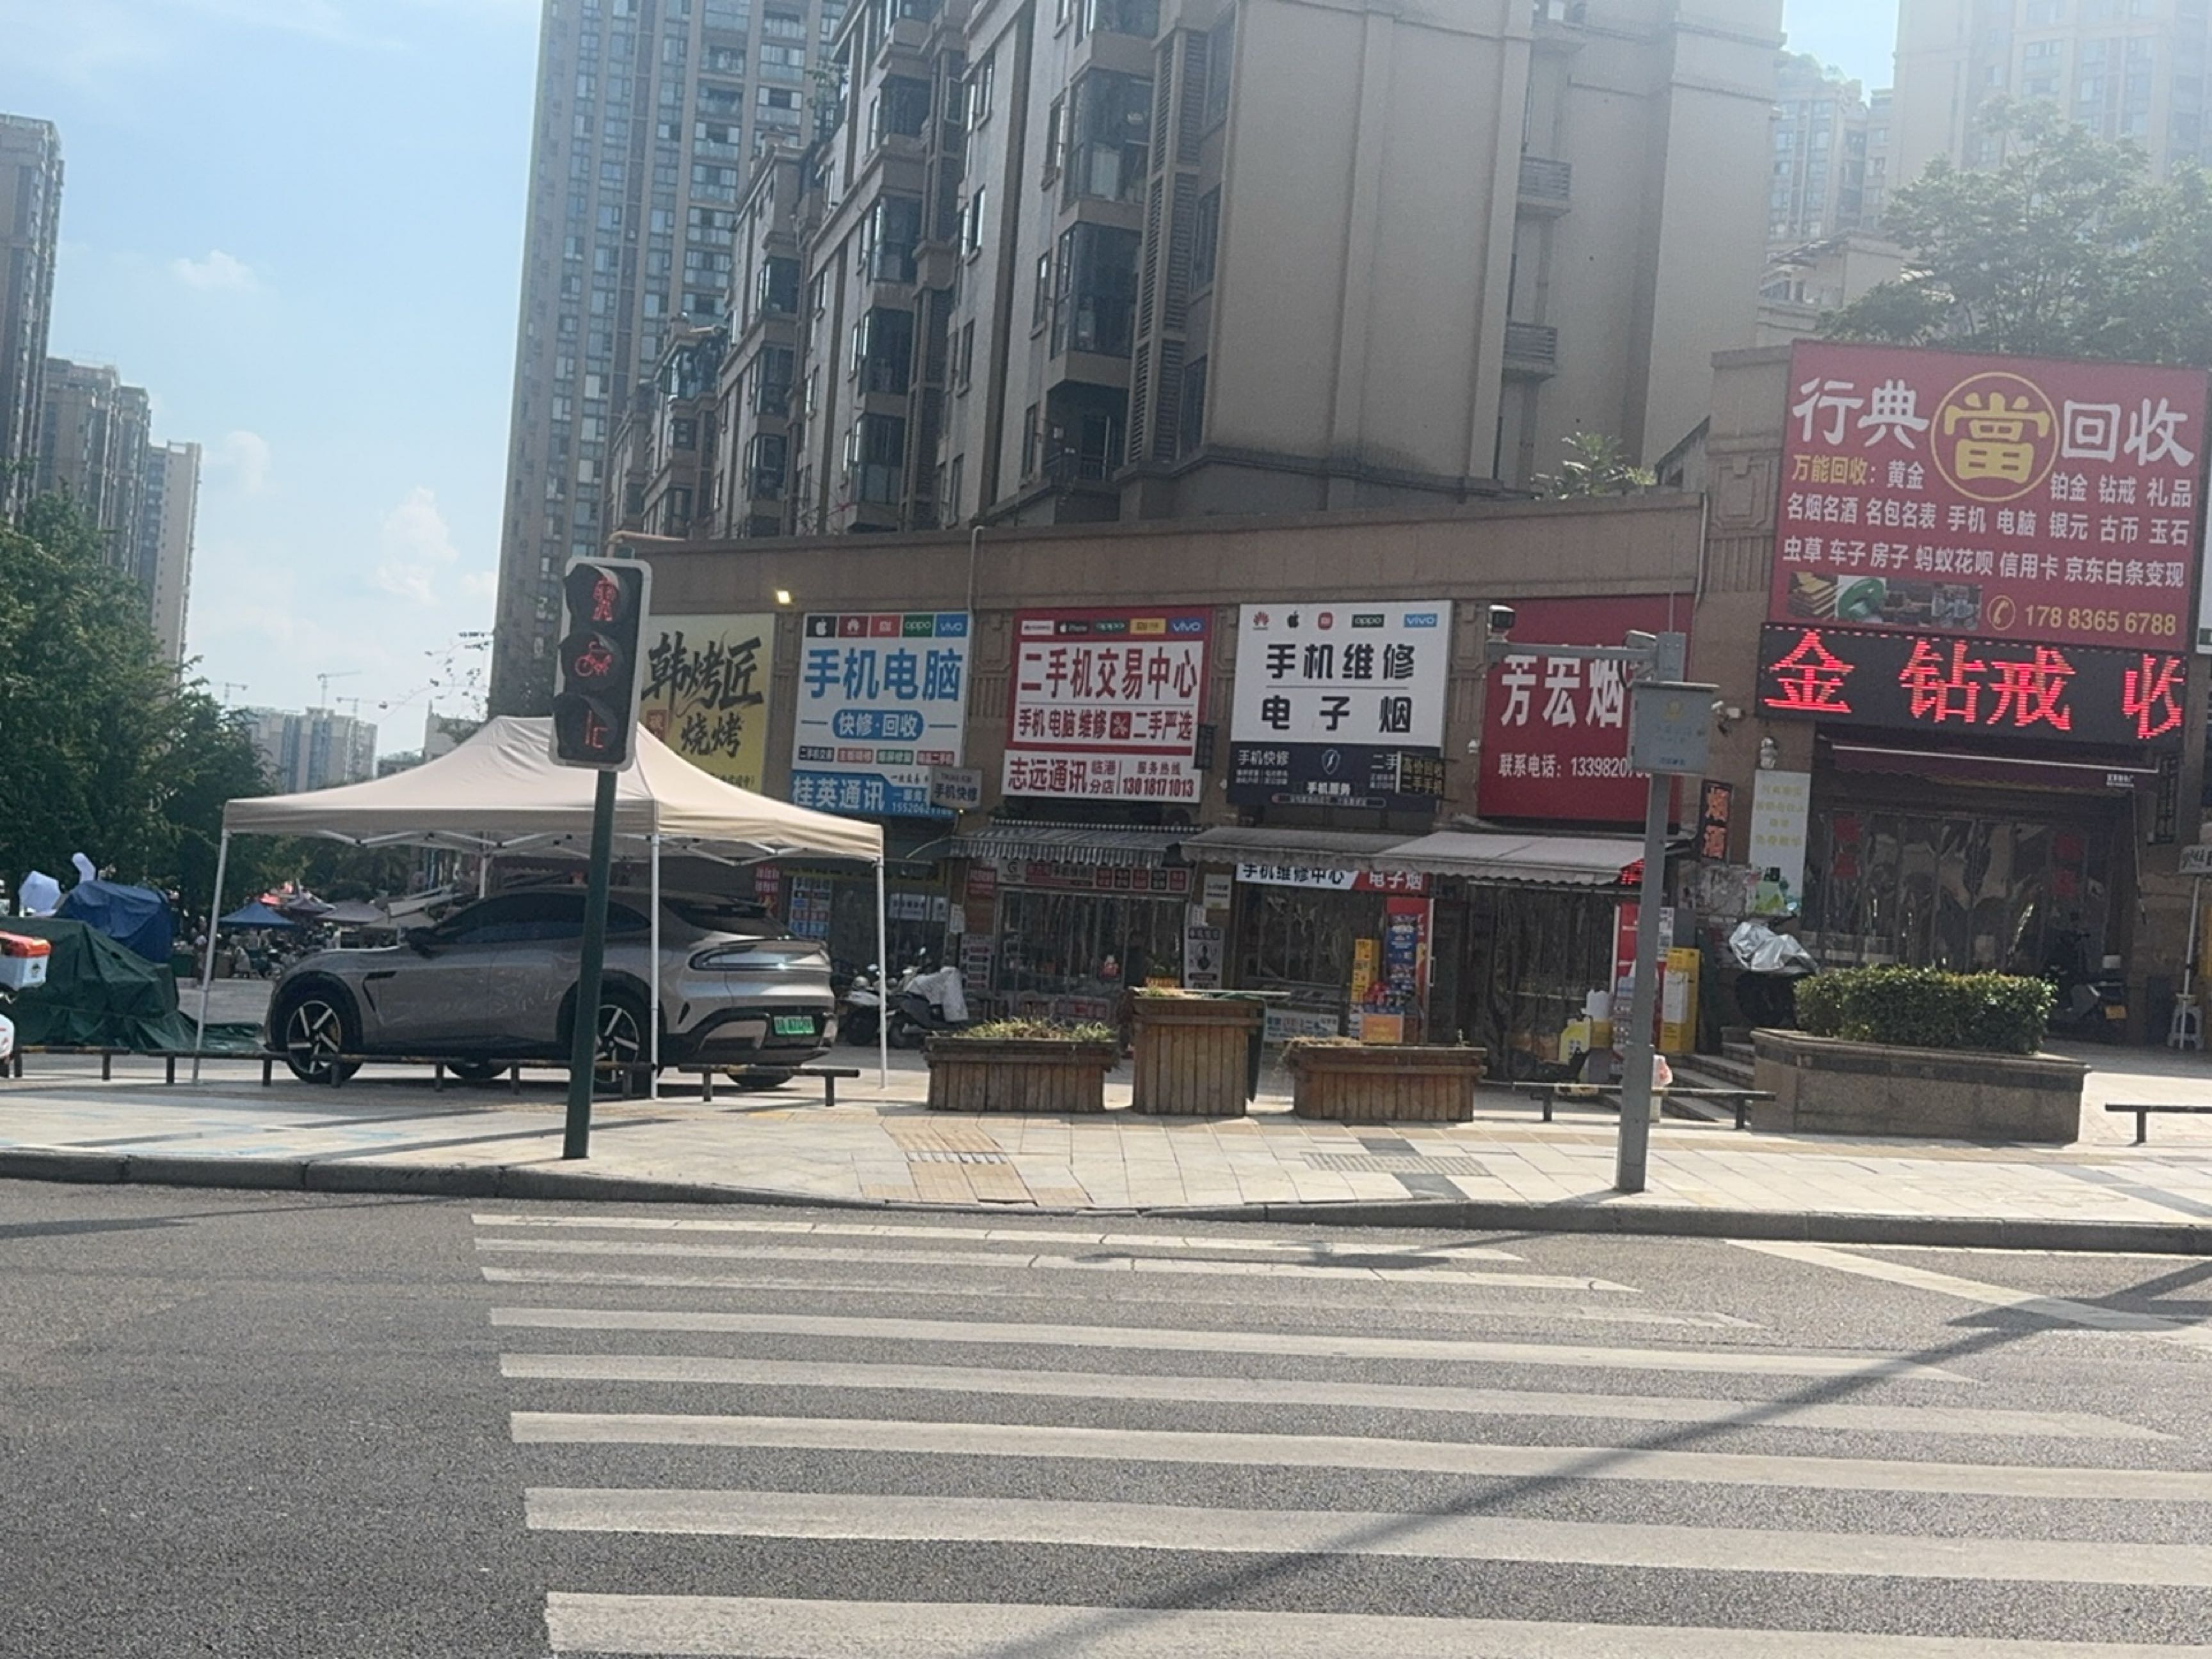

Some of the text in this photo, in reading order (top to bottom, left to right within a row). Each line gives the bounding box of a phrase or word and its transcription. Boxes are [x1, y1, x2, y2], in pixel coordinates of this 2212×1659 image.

[1793, 377, 1930, 449] 行典
[2062, 397, 2194, 467] 回收
[1886, 460, 1924, 489] 黄金
[2051, 471, 2087, 502] 铂金
[2098, 474, 2137, 504] 钻戒
[2147, 477, 2192, 508] 礼品
[1787, 493, 2190, 545] 名烟名酒 名包名表 手机 电脑 银元 古币 玉石
[1783, 535, 2184, 588] 虫草 车子 房子 蚂蚁花呗 信用卡 京东白条变现
[2025, 605, 2176, 636] 178 8365 6788
[805, 647, 963, 701] 手机电脑
[1022, 646, 1197, 700] 二手机交易中心
[1266, 643, 1415, 679] 手机维修
[1764, 629, 1855, 713] 金
[1898, 639, 2075, 730] 钻戒
[1501, 645, 1640, 728] 芳宏烟
[681, 712, 743, 758] 烧烤
[1019, 709, 1192, 741] 手机电脑维修 二手严选
[1261, 695, 1412, 733] 电子烟
[792, 776, 885, 810] 桂英通讯
[1008, 757, 1087, 793] 志远通讯
[1243, 864, 1423, 890] 手机维修中心 电子烟
